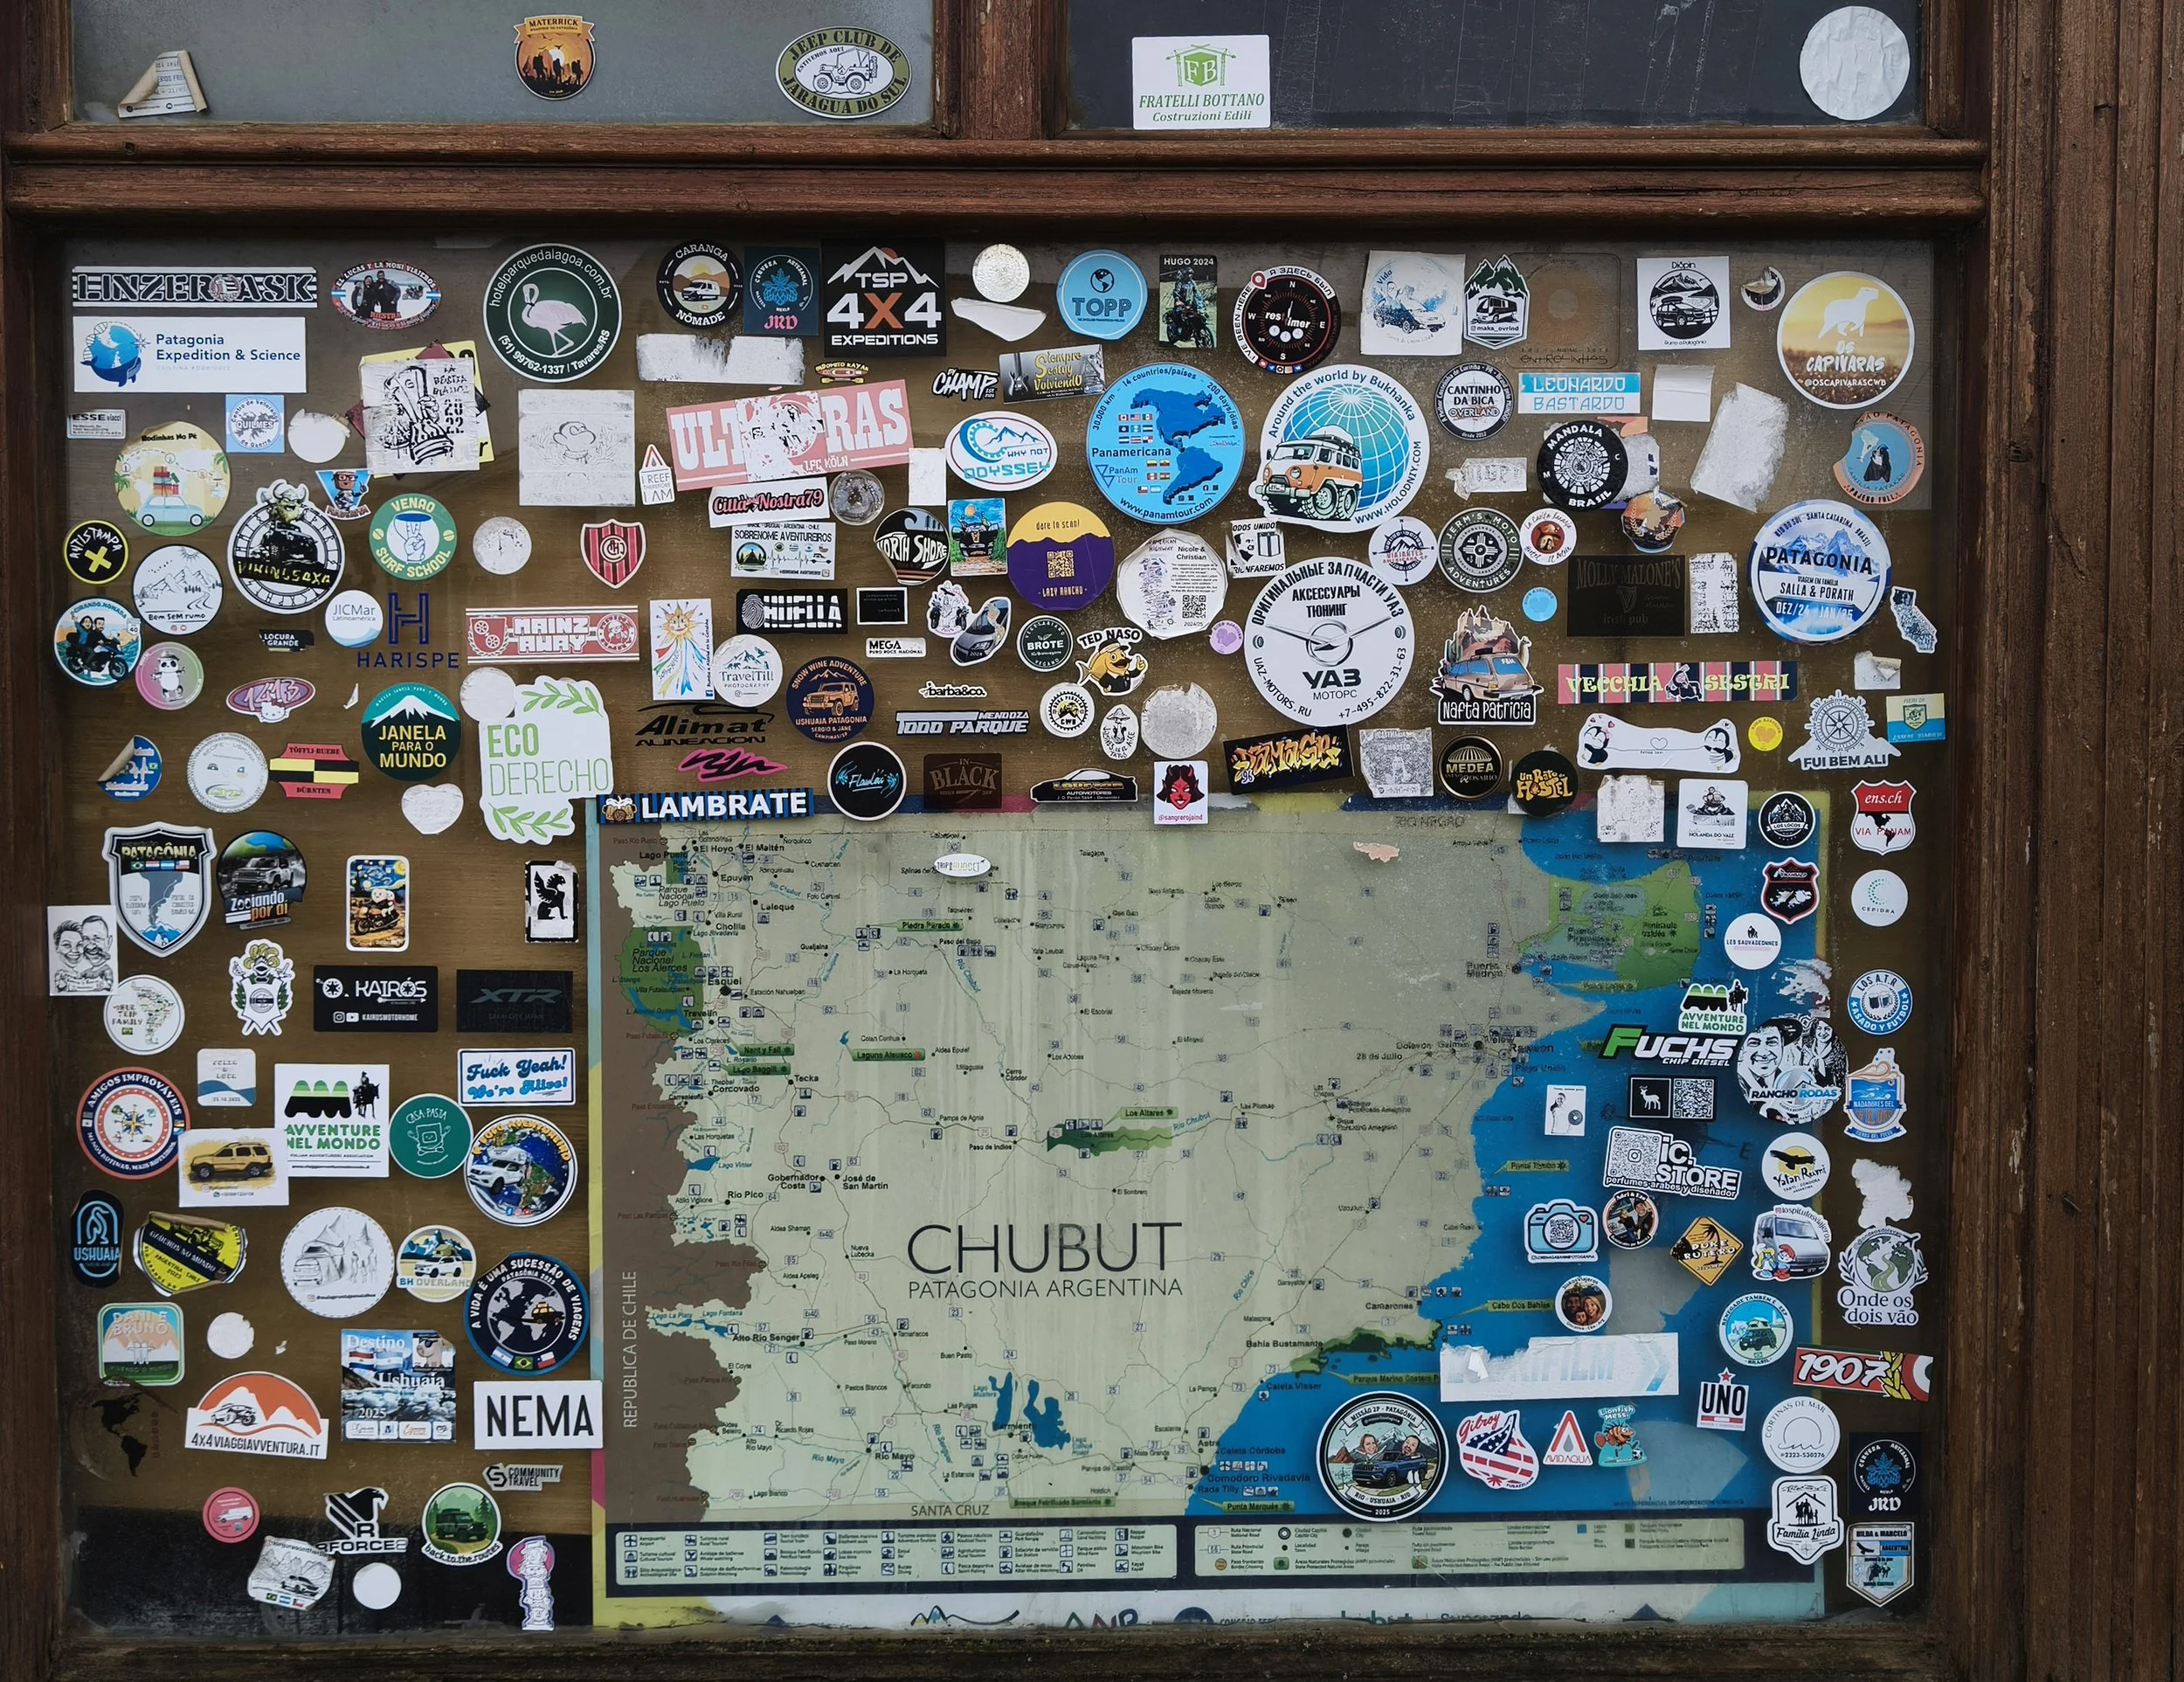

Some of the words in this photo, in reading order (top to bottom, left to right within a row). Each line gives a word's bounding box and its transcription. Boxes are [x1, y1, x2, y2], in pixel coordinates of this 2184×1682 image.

[529, 18, 578, 27] MATERRICK
[789, 32, 827, 60] JEEP
[833, 31, 876, 46] CLUB
[879, 43, 902, 63] DE
[797, 50, 827, 73] ESTIVEMOS
[784, 77, 852, 114] JARAGUÁ
[857, 98, 879, 113] DO
[880, 77, 907, 104] SUL
[1139, 94, 1200, 108] FRATELLI
[1203, 93, 1265, 107] BOTTANO
[1152, 112, 1221, 121] Costruzioni
[1224, 111, 1252, 121] Edili
[674, 244, 729, 262] CARANGA
[488, 248, 612, 308] hotelparquedalagoa.com.br
[854, 272, 909, 288] TSP
[1280, 267, 1312, 279] ЗДЕСЬ
[1314, 278, 1332, 297] БЫЛ
[827, 292, 942, 329] 4X4
[1071, 296, 1132, 317] TOPP
[674, 309, 726, 326] NÔMADE
[156, 334, 225, 348] Patagonia
[831, 334, 939, 346] EXPEDITIONS
[156, 350, 231, 363] Expedition
[235, 350, 245, 360] &
[250, 350, 301, 361] Science
[1805, 356, 1886, 373] CAPIVARAS
[1448, 385, 1501, 394] CANTINHO
[1533, 377, 1626, 391] LEONARDO
[1803, 377, 1887, 388] @OSCAPIVARASCWB
[1268, 397, 1295, 438] Around
[1293, 380, 1313, 400] the
[1313, 369, 1349, 386] world
[1352, 370, 1367, 383] by
[1370, 374, 1417, 421] Bukhanka
[1454, 396, 1469, 405] DA
[1471, 396, 1495, 405] BICA
[1533, 397, 1625, 411] BASTARDO
[1448, 407, 1500, 418] OVERLAND
[1546, 424, 1603, 449] MANDALA
[1092, 447, 1171, 457] Panamericana
[1354, 440, 1421, 524] WWW.HOLODNIY.COM
[391, 496, 436, 514] VENAO
[1567, 490, 1614, 508] BRASIL
[1120, 497, 1213, 519] www.panamtour.com
[1445, 513, 1482, 539] JERM'S
[1493, 516, 1517, 543] MOTO
[377, 547, 404, 575] SURF
[407, 549, 451, 578] SCHOOL
[1766, 547, 1872, 575] PATAGONIA
[1448, 566, 1510, 588] ADVENTURES
[1252, 561, 1324, 626] ОРИГИНАЛЬНЫЕ
[1328, 562, 1387, 595] ЗАПЧАСТИ
[1381, 597, 1405, 619] УАЗ
[1292, 585, 1361, 601] АКСЕССУАРЫ
[1780, 583, 1807, 596] SALLA
[1809, 585, 1816, 597] &
[1820, 586, 1854, 601] PORATH
[332, 605, 377, 617] JICMar
[1306, 603, 1347, 618] ТЮНИНГ
[514, 617, 590, 635] MAINZ
[868, 640, 902, 649] MEGA
[1026, 639, 1064, 650] BROTE
[1078, 631, 1104, 647] TED
[1106, 629, 1141, 640] NASO
[357, 653, 460, 668] HARISPE
[791, 668, 809, 689] SNOW
[808, 661, 828, 674] WINE
[830, 661, 868, 687] ADVENTURE
[1303, 669, 1362, 689] УАЗ
[1338, 647, 1406, 719] +7-495-822-31-63
[1565, 675, 1663, 692] VECCHIA
[1704, 674, 1790, 691] SESTRI
[1312, 689, 1358, 701] МОТОРС
[1443, 702, 1480, 719] Nafta
[1483, 701, 1531, 719] Patricia
[636, 714, 770, 737] Alimat
[795, 717, 826, 726] USHUAIA
[378, 725, 446, 741] JANELA
[487, 723, 539, 758] ECO
[392, 742, 421, 751] PARA
[425, 742, 433, 751] O
[379, 753, 447, 768] MUNDO
[1803, 757, 1826, 768] FUI
[1828, 755, 1857, 767] BEM
[1860, 753, 1886, 765] ALI
[489, 758, 609, 796] DERECHO
[641, 793, 807, 819] LAMBRATE
[1863, 792, 1903, 806] ens.ch
[712, 846, 733, 855] Hoyo
[708, 977, 742, 986] Esquel
[470, 988, 563, 1004] XTR
[1682, 1013, 1745, 1024] AVVENTURE
[1682, 1021, 1701, 1030] NEL
[1703, 1021, 1745, 1032] MONDO
[1603, 1028, 1737, 1059] FUCHS
[467, 1062, 510, 1083] Fuck
[516, 1055, 567, 1079] Yeah!
[1662, 1056, 1689, 1065] CHIP
[1691, 1058, 1730, 1067] DIESEL
[1751, 1089, 1798, 1100] RANCHO
[1799, 1088, 1838, 1098] RODAS
[286, 1124, 381, 1136] AVVENTURE
[287, 1138, 313, 1150] NEL
[316, 1137, 381, 1150] MONDO
[1656, 1165, 1737, 1192] STORE
[908, 1222, 1183, 1275] CHUBUT
[1683, 1244, 1736, 1260] RUTERO
[1691, 1239, 1729, 1251] DUKE
[622, 1271, 636, 1323] CHILE
[909, 1280, 1040, 1299] PATAGONIA
[1047, 1278, 1183, 1298] ARGENTINA
[470, 1291, 482, 1319] VIDA
[480, 1281, 488, 1291] É
[487, 1262, 508, 1284] UMA
[510, 1259, 563, 1279] SUCESSÃO
[562, 1277, 576, 1293] DE
[569, 1296, 583, 1340] VIAGENS
[1839, 1288, 1889, 1307] Onde
[1893, 1295, 1912, 1307] os
[1848, 1307, 1883, 1323] dois
[1888, 1309, 1918, 1325] vão
[346, 1335, 405, 1350] Destino
[623, 1326, 637, 1346] DE
[1800, 1353, 1889, 1385] 1907
[378, 1373, 446, 1390] Ushuaia
[624, 1360, 637, 1428] REPUBLICA
[1702, 1383, 1745, 1415] UNO
[358, 1407, 387, 1419] 2025
[487, 1395, 595, 1437] NEMA
[1765, 1406, 1795, 1438] CORTINAS
[1808, 1401, 1827, 1415] MAR
[508, 1467, 559, 1478] COMMUNITY
[508, 1476, 540, 1486] TRAVEL
[1207, 1474, 1261, 1483] Comodoro
[1262, 1473, 1310, 1483] Rivadavia
[1220, 1485, 1240, 1496] Tilly
[911, 1505, 952, 1516] SANTA
[956, 1505, 989, 1515] CRUZ
[1776, 1527, 1810, 1540] Familia
[1812, 1527, 1836, 1539] Linda
